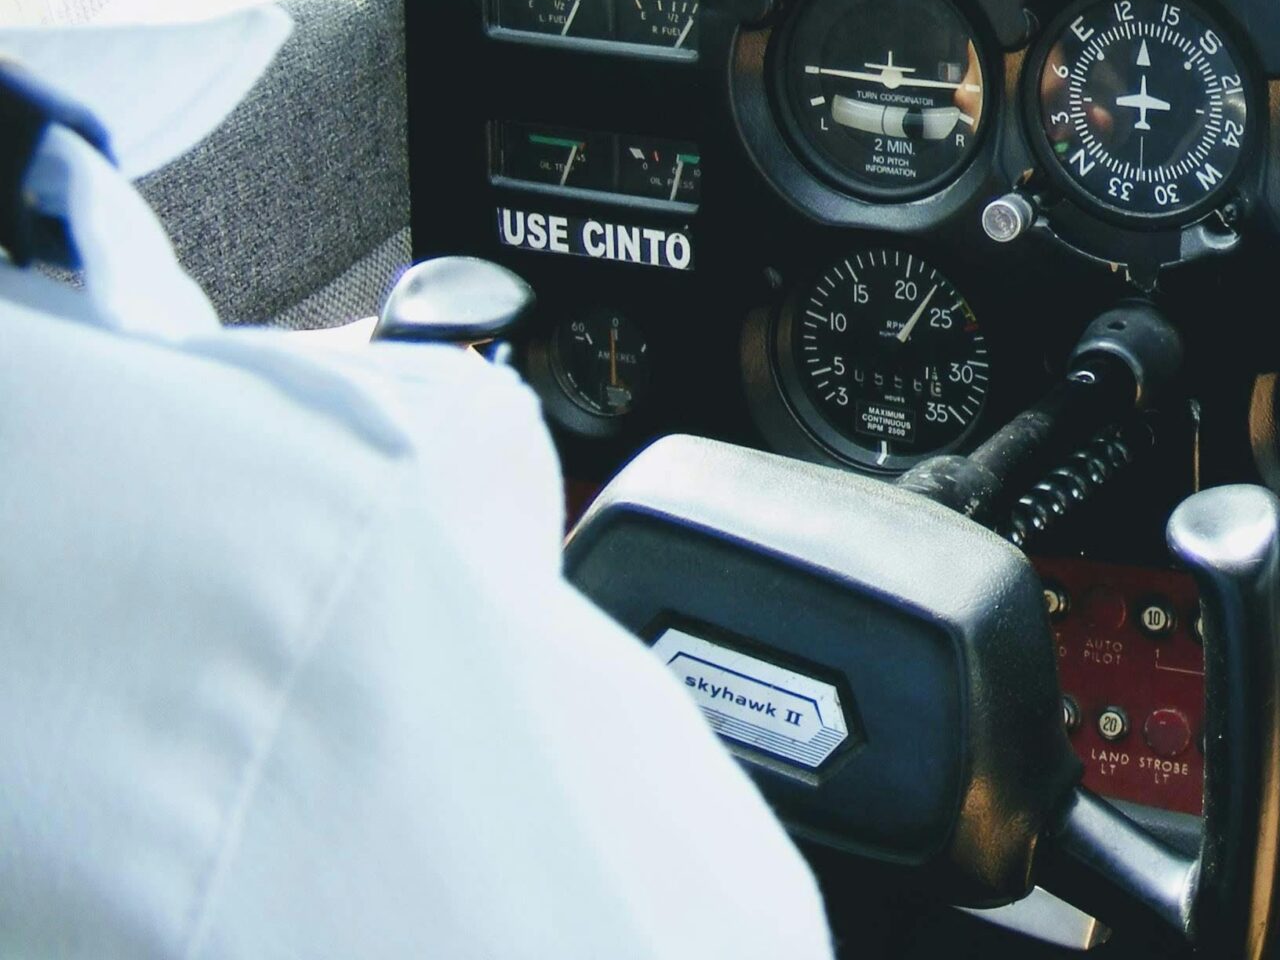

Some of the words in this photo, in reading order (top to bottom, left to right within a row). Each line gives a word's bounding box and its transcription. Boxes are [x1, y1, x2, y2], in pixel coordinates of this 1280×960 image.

[1114, 1, 1134, 22] 12
[1161, 4, 1181, 26] 15
[1221, 73, 1244, 94] 21
[857, 90, 877, 101] TURN
[880, 93, 934, 106] COORDINATOR
[1222, 120, 1244, 148] 24
[865, 164, 916, 177] INFORMATION
[887, 156, 909, 167] PITCH
[1108, 177, 1134, 201] 33
[1154, 184, 1180, 205] 30
[501, 208, 569, 253] USE
[582, 219, 692, 270] CINTO
[853, 284, 869, 304] 15
[895, 280, 917, 301] 20
[572, 321, 584, 332] 60
[830, 312, 847, 332] 10
[930, 308, 952, 329] 25
[949, 363, 973, 384] 30
[862, 414, 911, 429] CONTINUOUS
[869, 406, 905, 419] MAXIMUM
[925, 402, 948, 423] 35
[867, 423, 883, 431] RPM
[685, 674, 776, 718] skyhawk
[784, 708, 803, 726] II
[1091, 748, 1130, 764] LAND
[1139, 757, 1189, 776] STROBE
